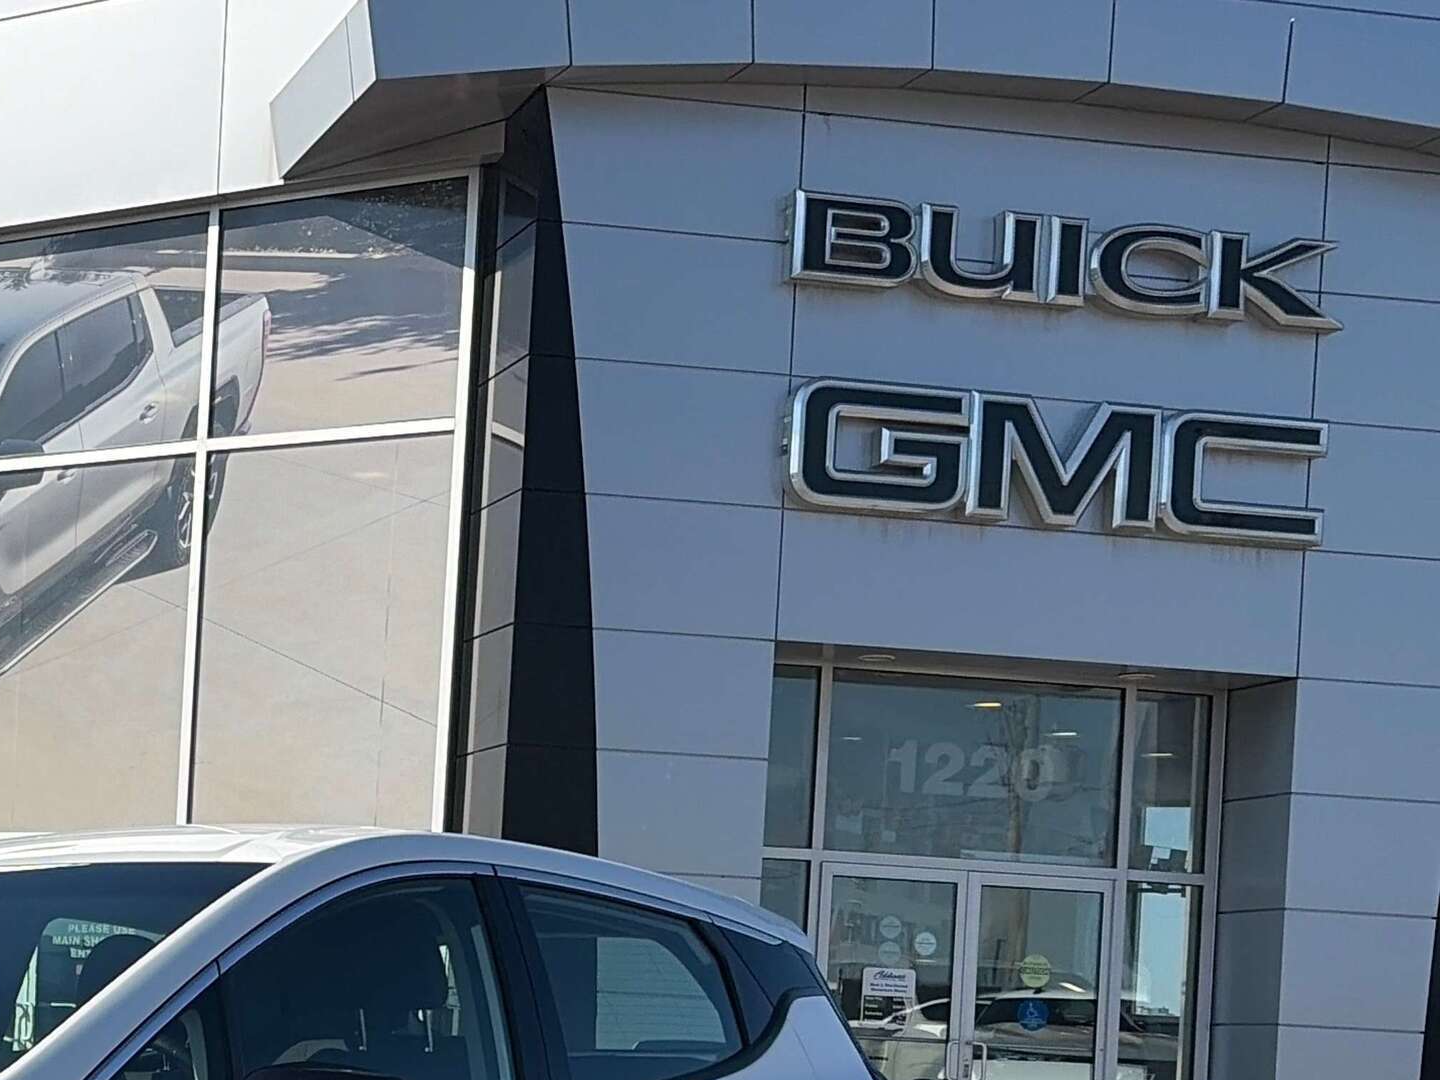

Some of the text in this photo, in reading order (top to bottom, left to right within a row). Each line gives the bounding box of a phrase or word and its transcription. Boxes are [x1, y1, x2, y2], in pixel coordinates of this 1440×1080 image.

[789, 188, 1344, 332] BUICK
[788, 377, 1329, 546] GMC
[887, 738, 1054, 802] 1220
[52, 935, 80, 946] MAIN
[67, 923, 137, 935] PLEASE USE
